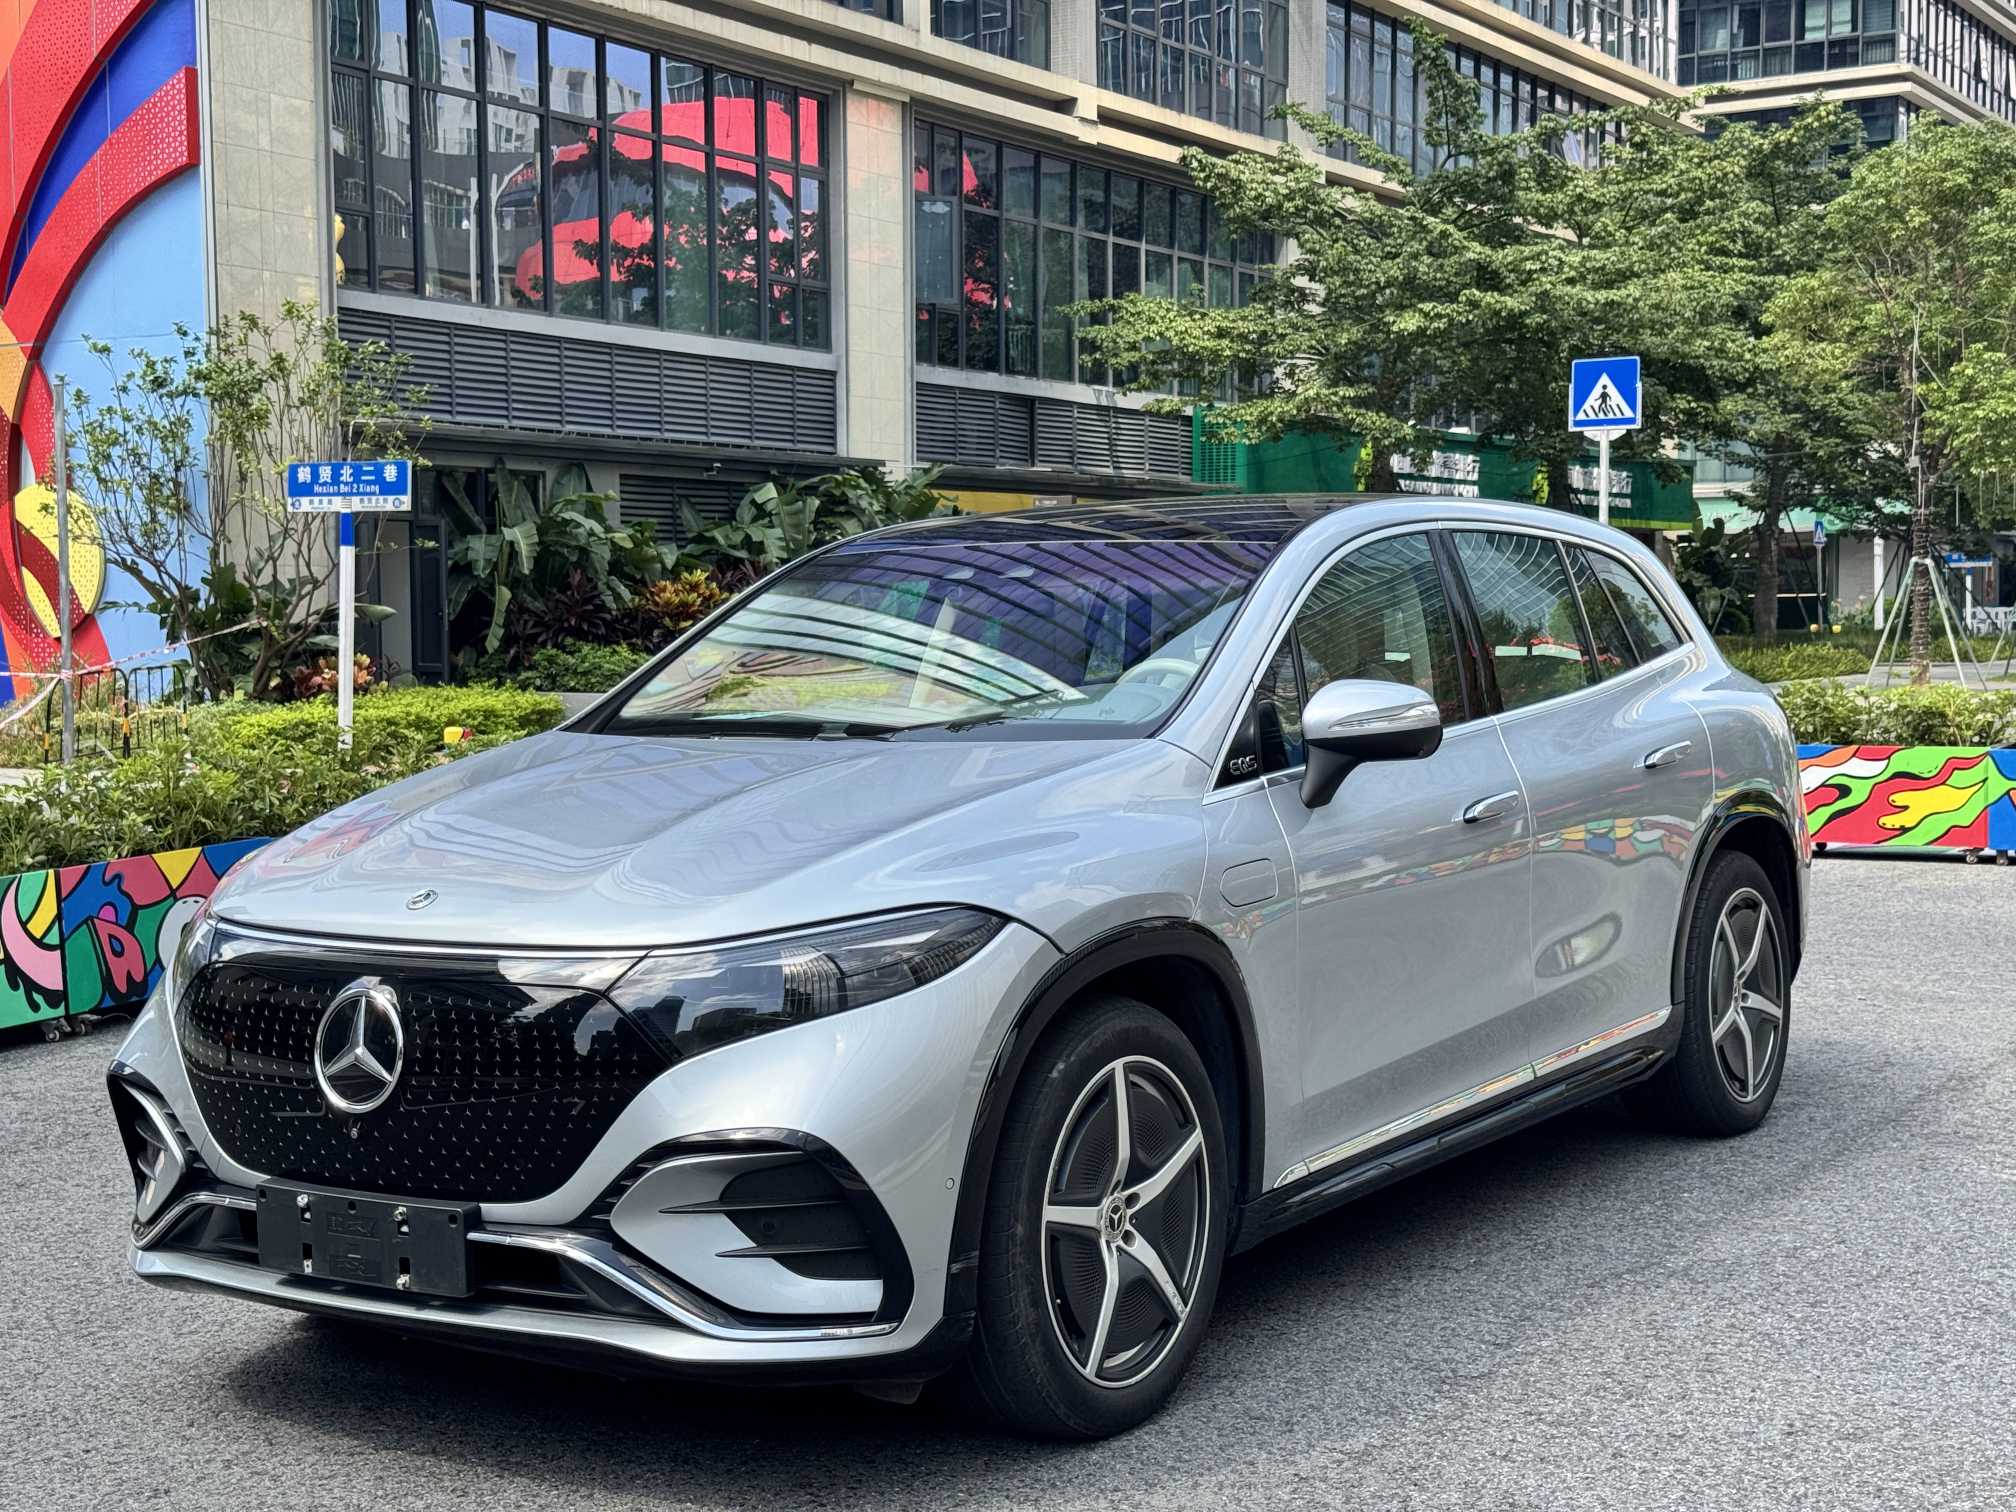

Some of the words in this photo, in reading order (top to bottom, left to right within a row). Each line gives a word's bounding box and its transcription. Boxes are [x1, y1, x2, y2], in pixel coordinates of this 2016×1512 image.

[297, 465, 398, 483] 鹤贤北二巷
[314, 484, 338, 493] Hexian
[339, 483, 351, 493] Bei
[352, 483, 358, 493] 2
[359, 483, 380, 495] Xiang
[1229, 755, 1257, 775] EQS
